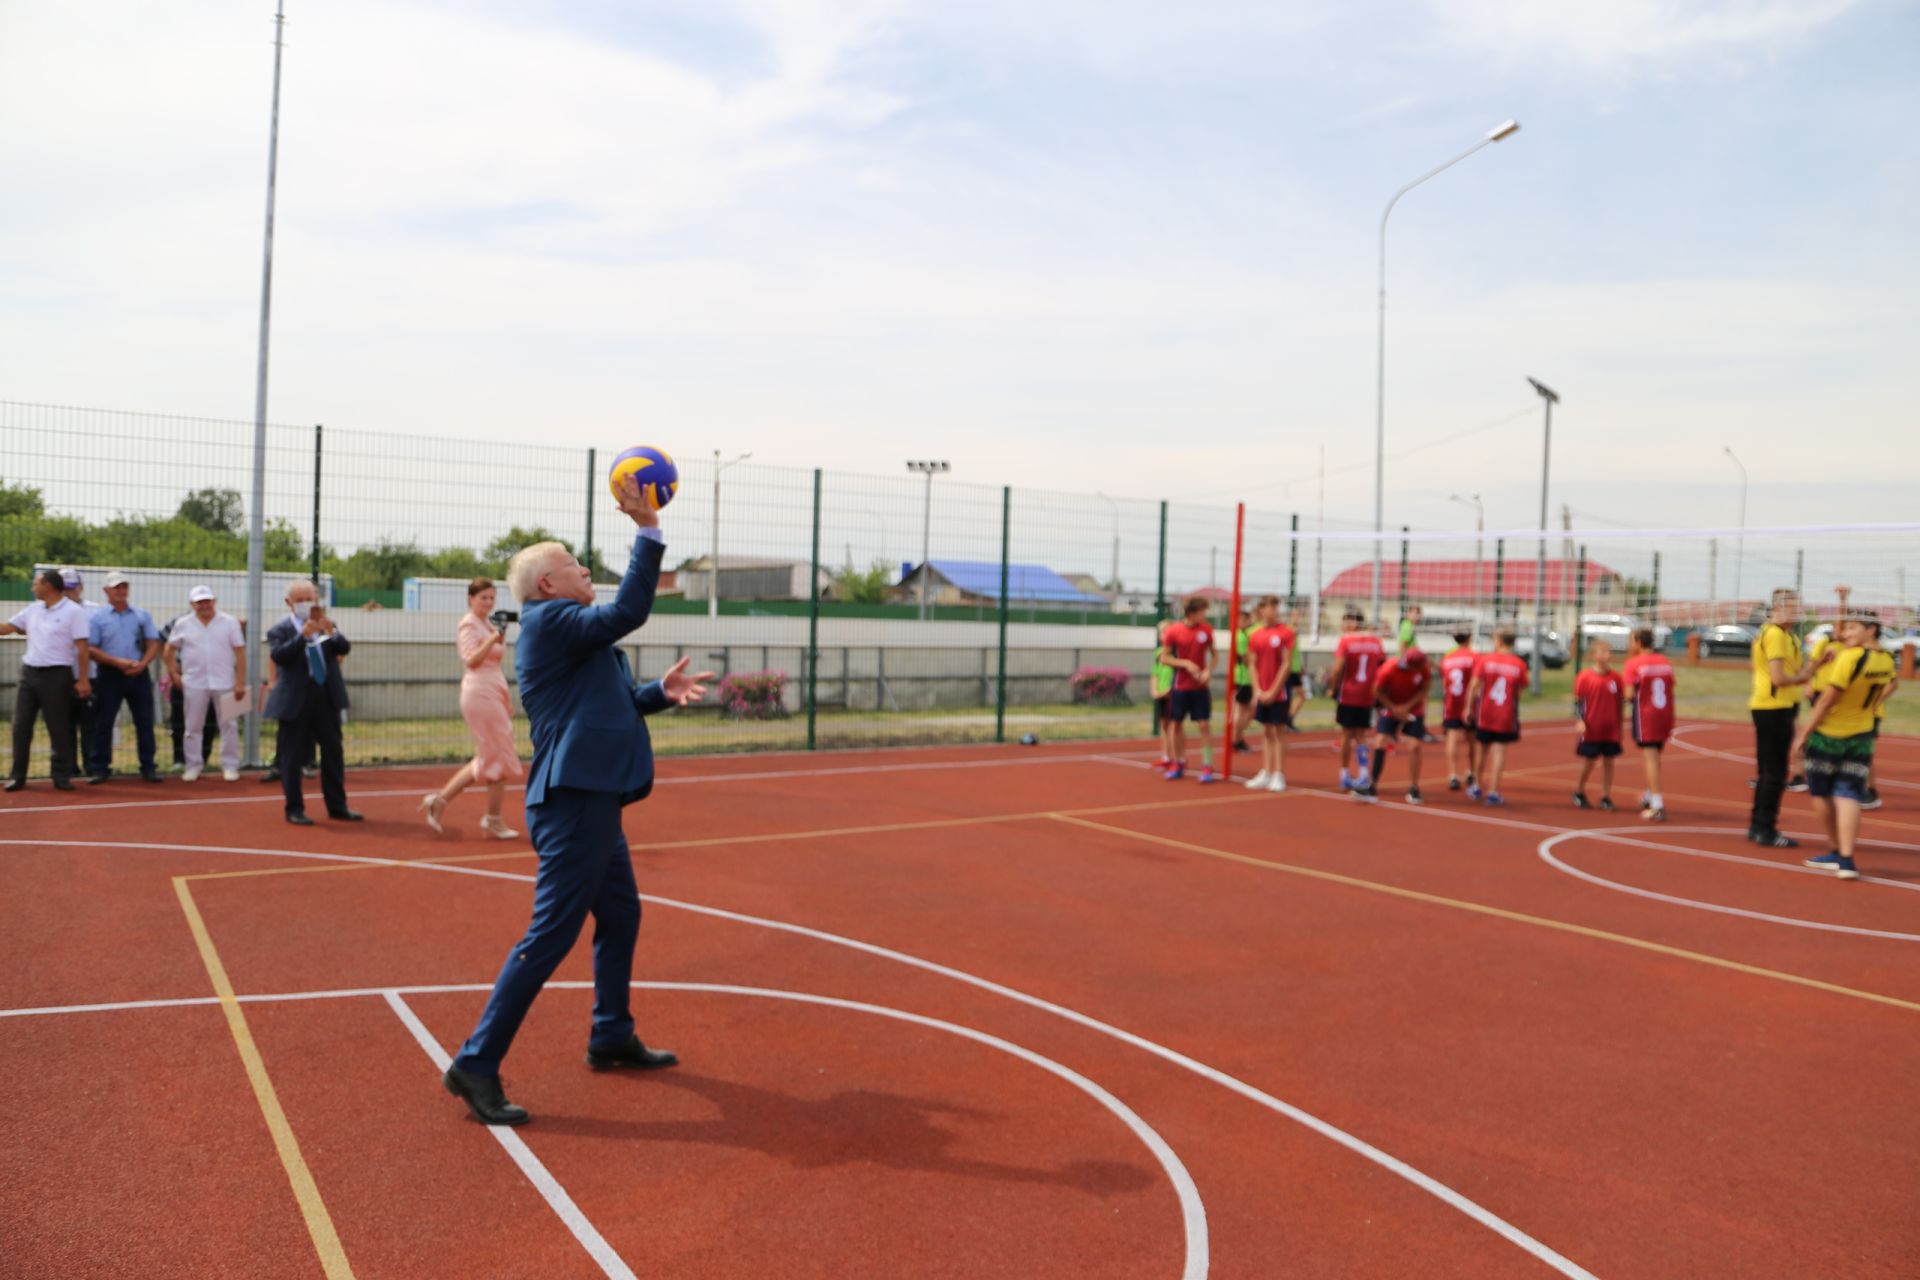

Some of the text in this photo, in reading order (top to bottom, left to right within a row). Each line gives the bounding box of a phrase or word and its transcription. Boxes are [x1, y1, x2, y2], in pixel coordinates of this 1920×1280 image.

[1357, 655, 1368, 683] 1
[1449, 669, 1464, 696] 3
[1489, 677, 1507, 706] 4
[1651, 678, 1667, 709] 8
